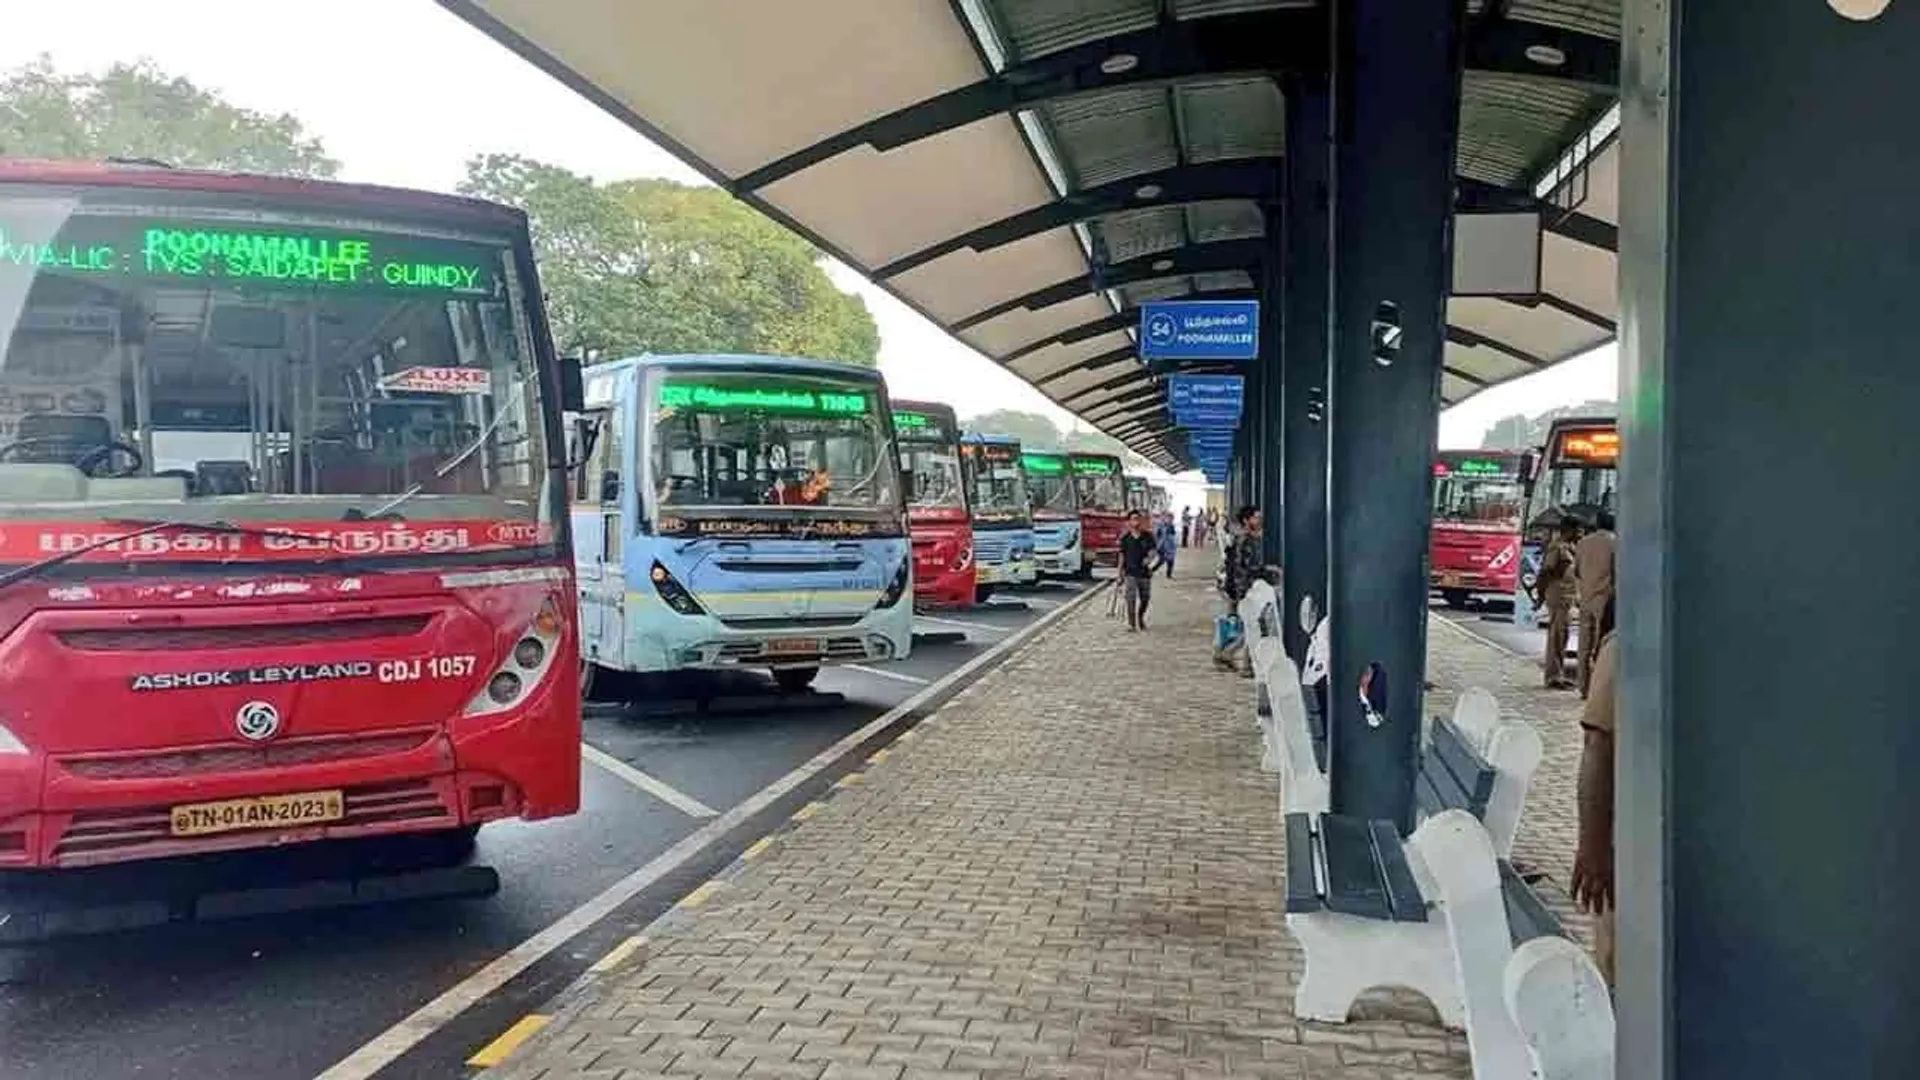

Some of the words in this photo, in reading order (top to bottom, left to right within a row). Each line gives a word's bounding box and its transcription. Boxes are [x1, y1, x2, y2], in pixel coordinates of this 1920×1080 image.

[140, 247, 201, 276] TVS
[225, 255, 360, 283] SAIDAPET
[383, 262, 481, 290] GUINDY
[131, 671, 231, 690] ASHOK
[249, 661, 372, 682] LEYLAND
[379, 661, 422, 682] CDJ
[427, 656, 476, 677] 1057
[189, 800, 326, 827] TN-01AN-2023
